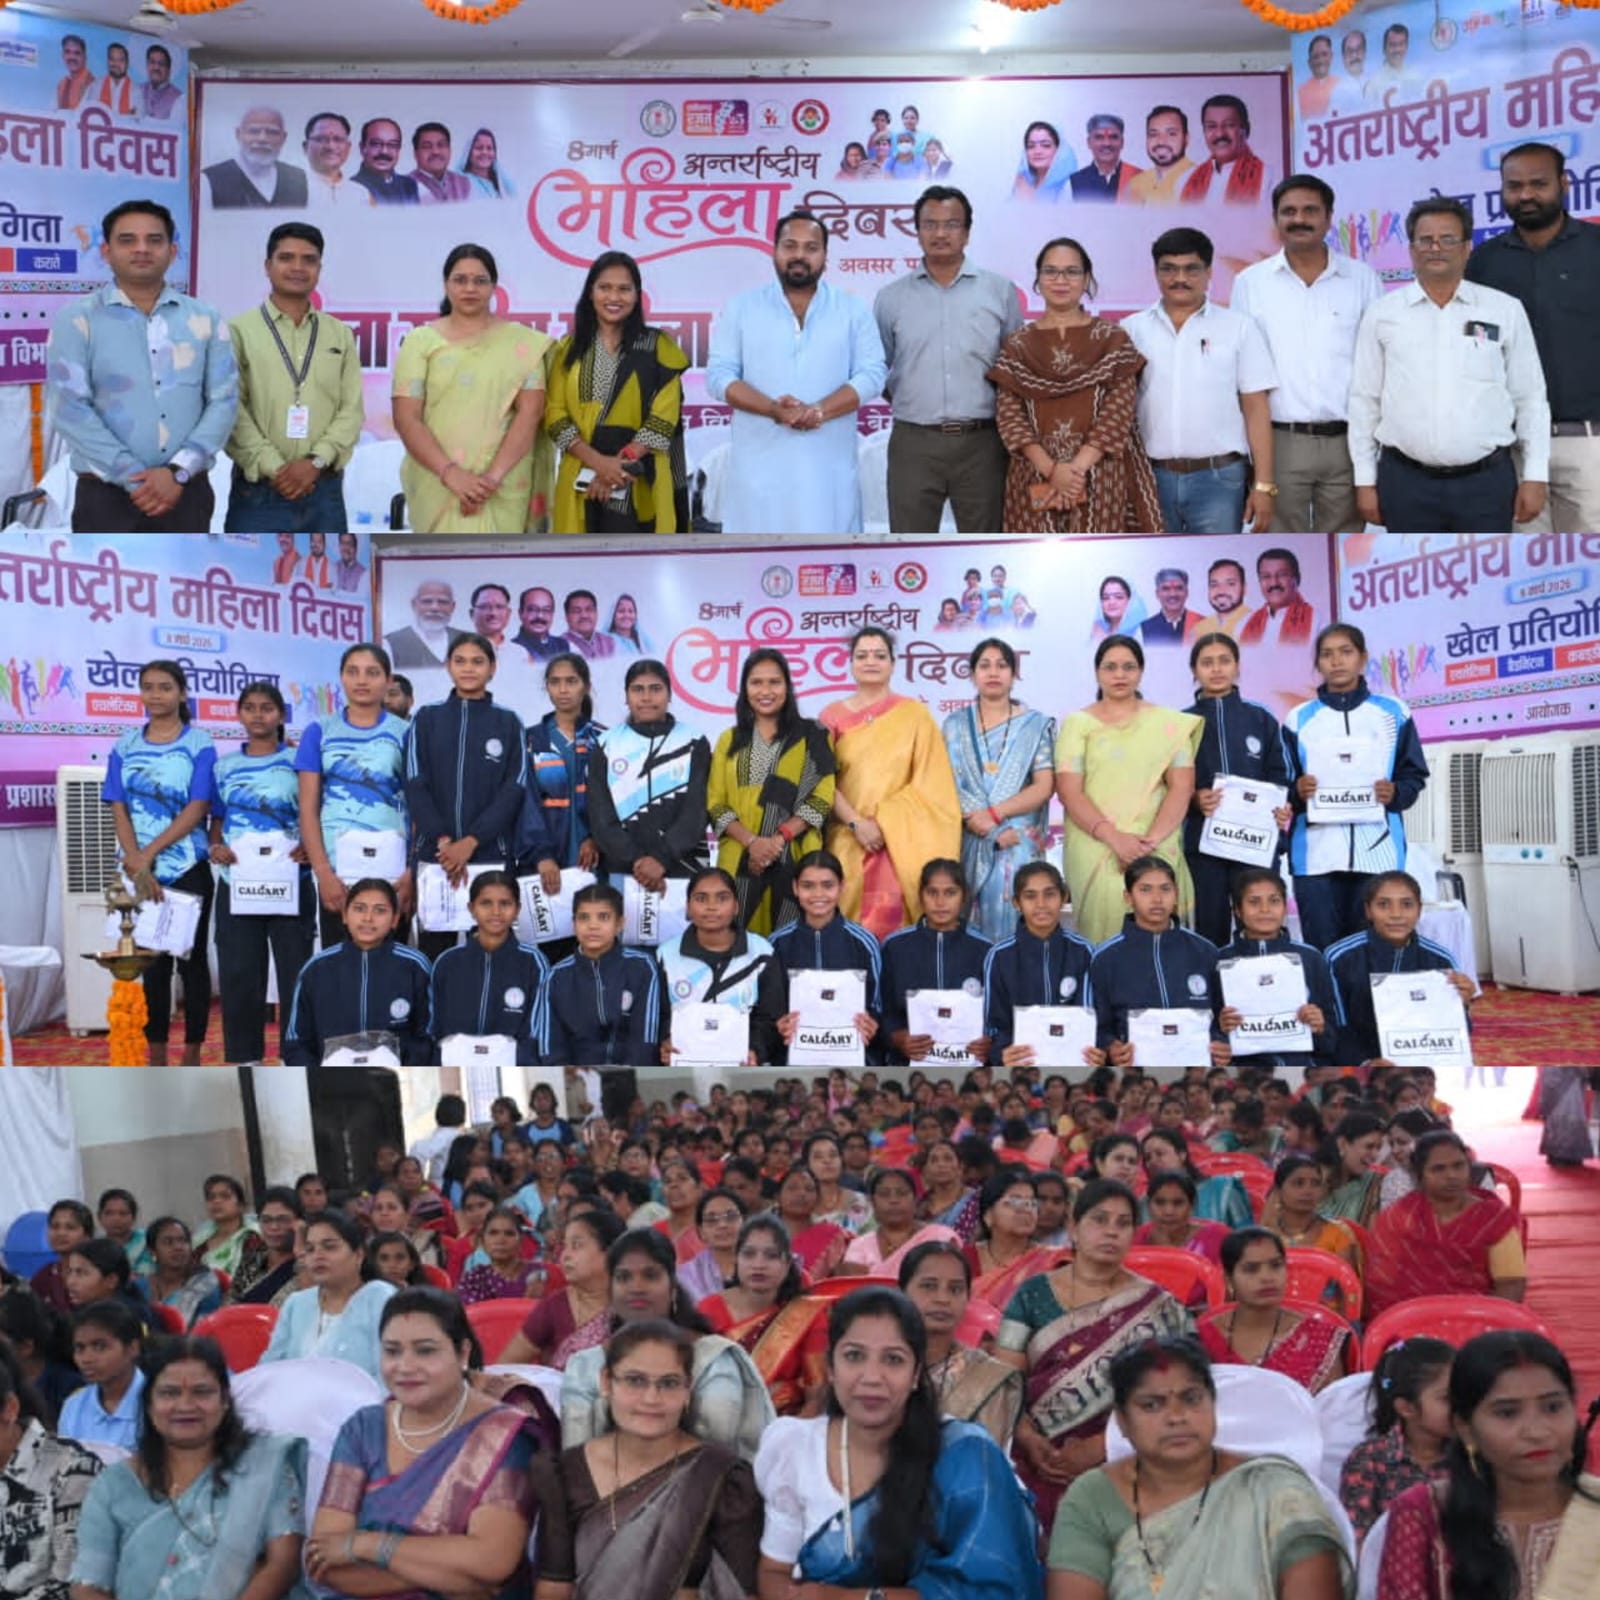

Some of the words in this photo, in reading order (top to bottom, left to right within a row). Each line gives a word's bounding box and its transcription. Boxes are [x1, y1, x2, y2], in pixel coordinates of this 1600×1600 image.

[78, 107, 178, 178] दिवस
[527, 147, 792, 268] महिला
[839, 257, 896, 275] अवसर
[170, 566, 281, 634] महिला
[290, 582, 365, 642] दिवस
[1445, 622, 1501, 658] खेल
[1319, 789, 1372, 804] CALGARY
[1213, 825, 1266, 845] CALGARY
[238, 883, 288, 897] CALGARY
[530, 885, 549, 934] CALGARY
[1240, 1016, 1297, 1033] CALGARY
[799, 1030, 852, 1045] CALGARY
[1393, 1032, 1455, 1050] CALGARY
